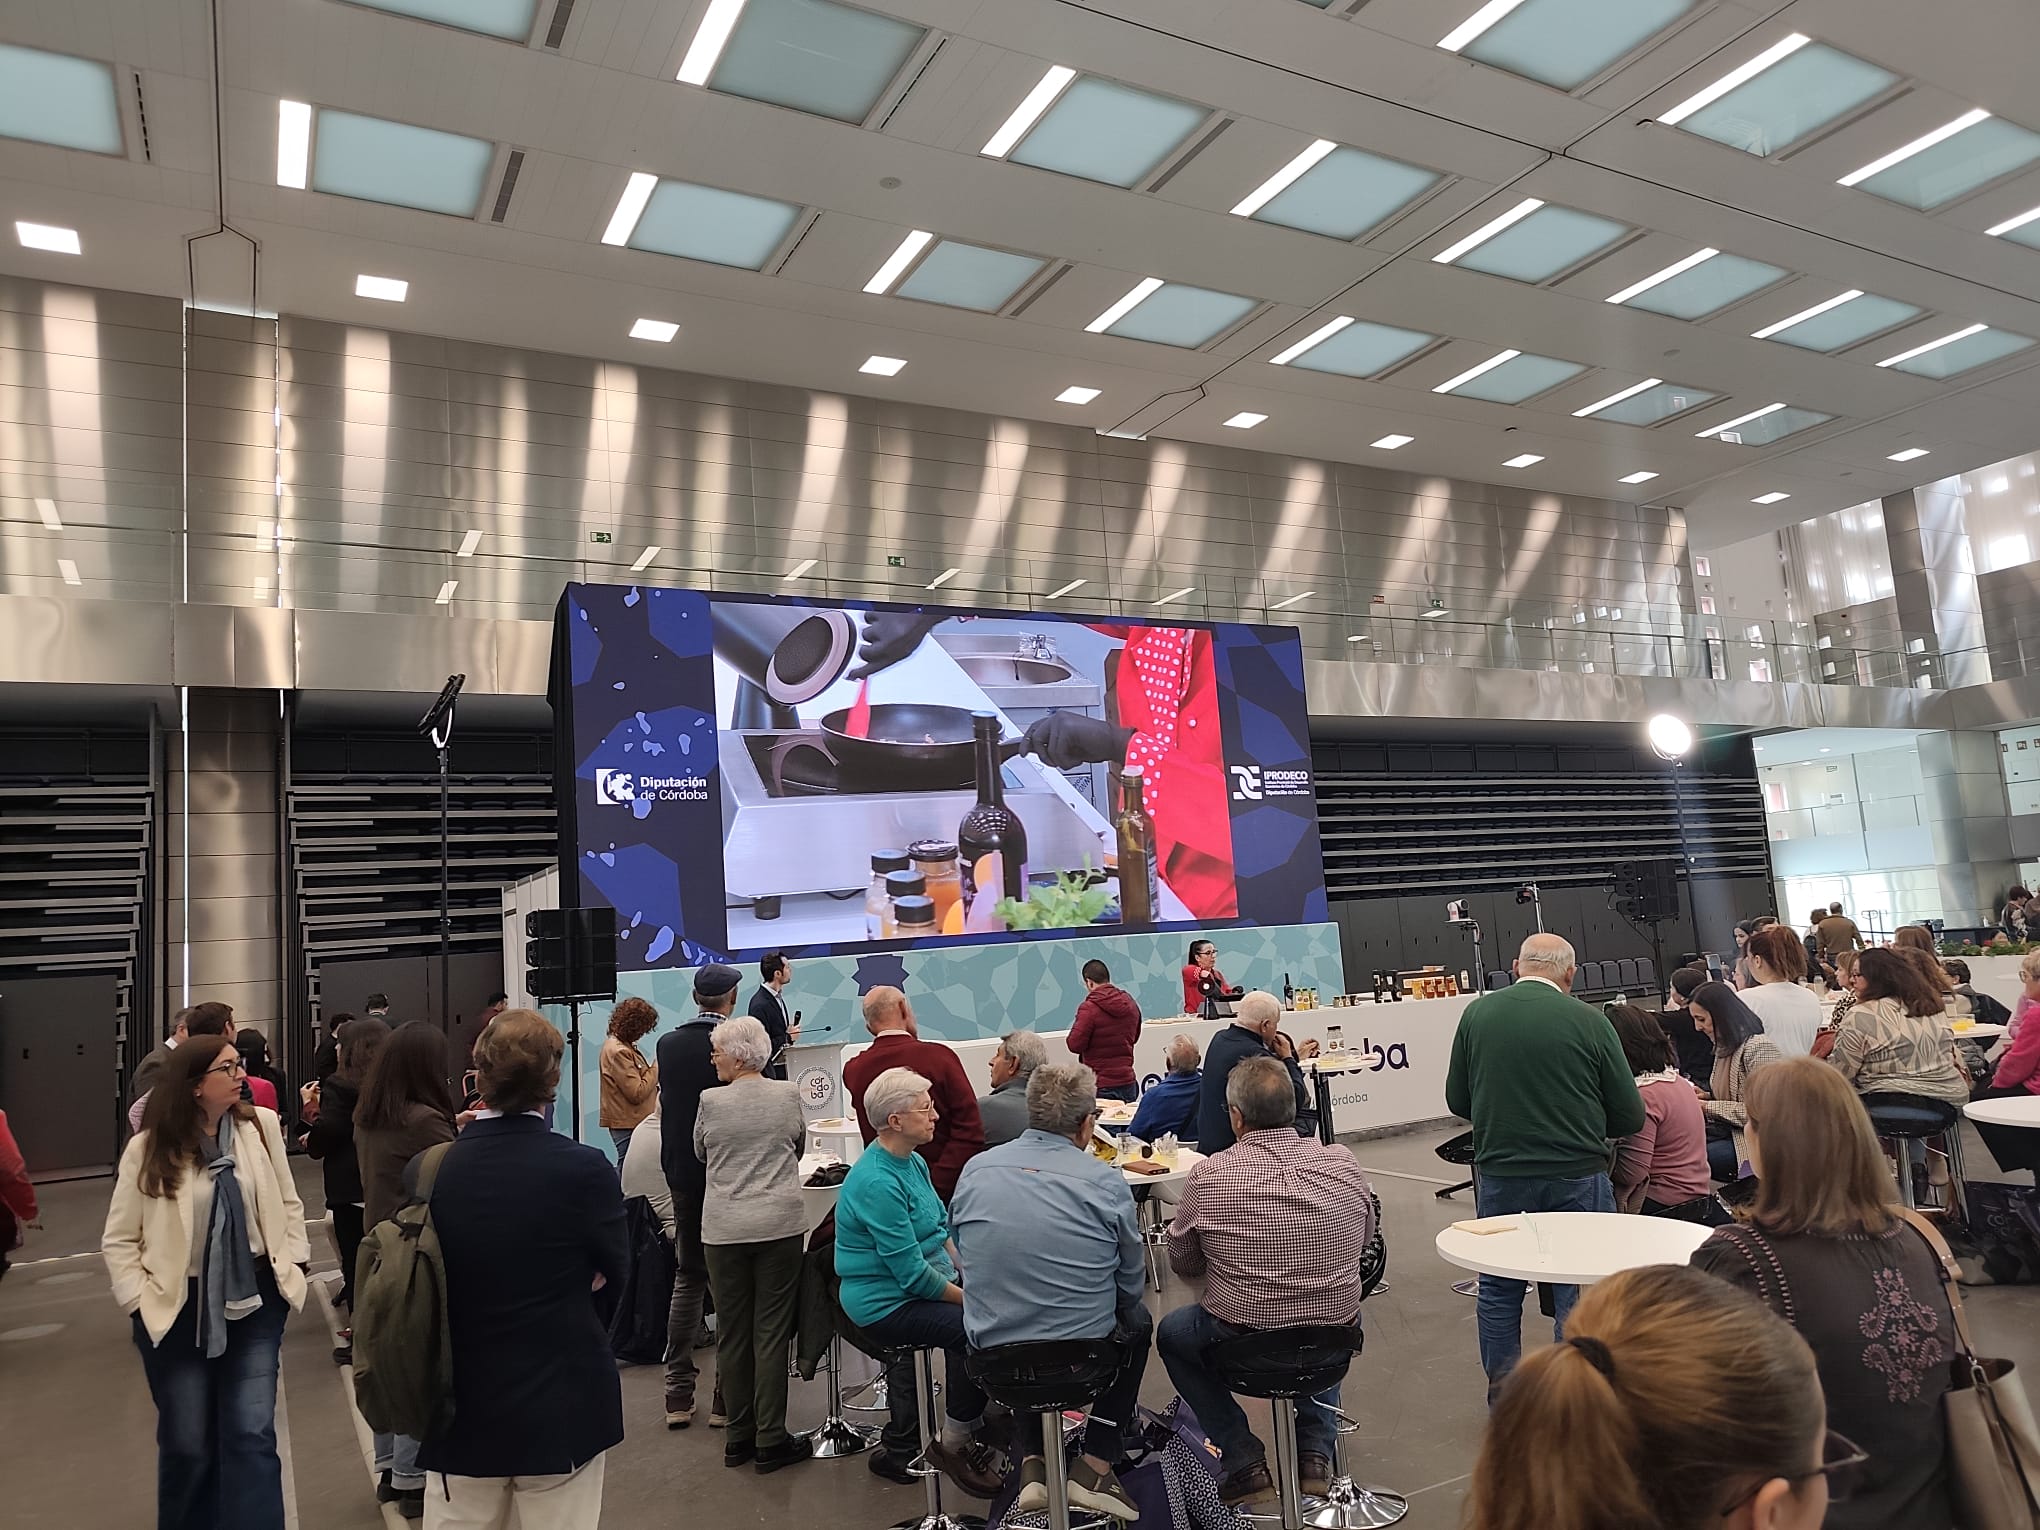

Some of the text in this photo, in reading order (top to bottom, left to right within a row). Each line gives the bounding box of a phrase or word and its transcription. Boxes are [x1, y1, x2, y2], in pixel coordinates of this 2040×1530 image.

[1263, 771, 1308, 780] IPRODECO
[640, 776, 706, 790] Diputación
[640, 788, 708, 800] de Córdoba
[1331, 1093, 1368, 1106] órdoba
